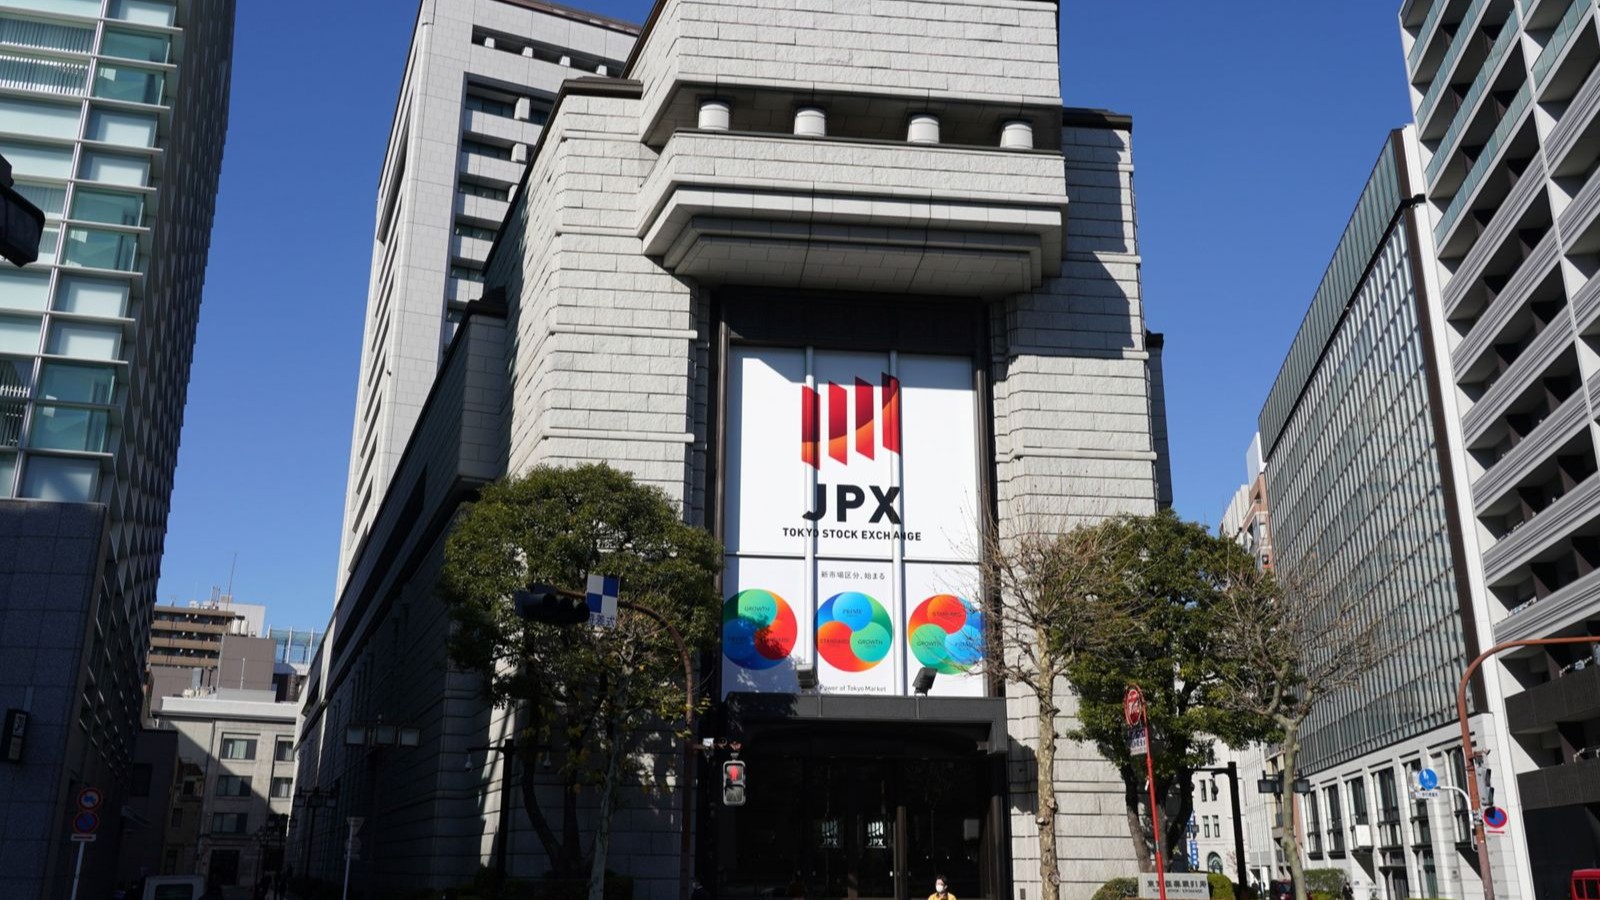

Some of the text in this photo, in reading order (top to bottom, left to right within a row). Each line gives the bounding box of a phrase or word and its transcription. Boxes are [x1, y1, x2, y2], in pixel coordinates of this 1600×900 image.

[802, 483, 902, 525] JPX
[782, 527, 922, 541] TOKYO STOCK EXCHANGE
[869, 838, 883, 846] JPX
